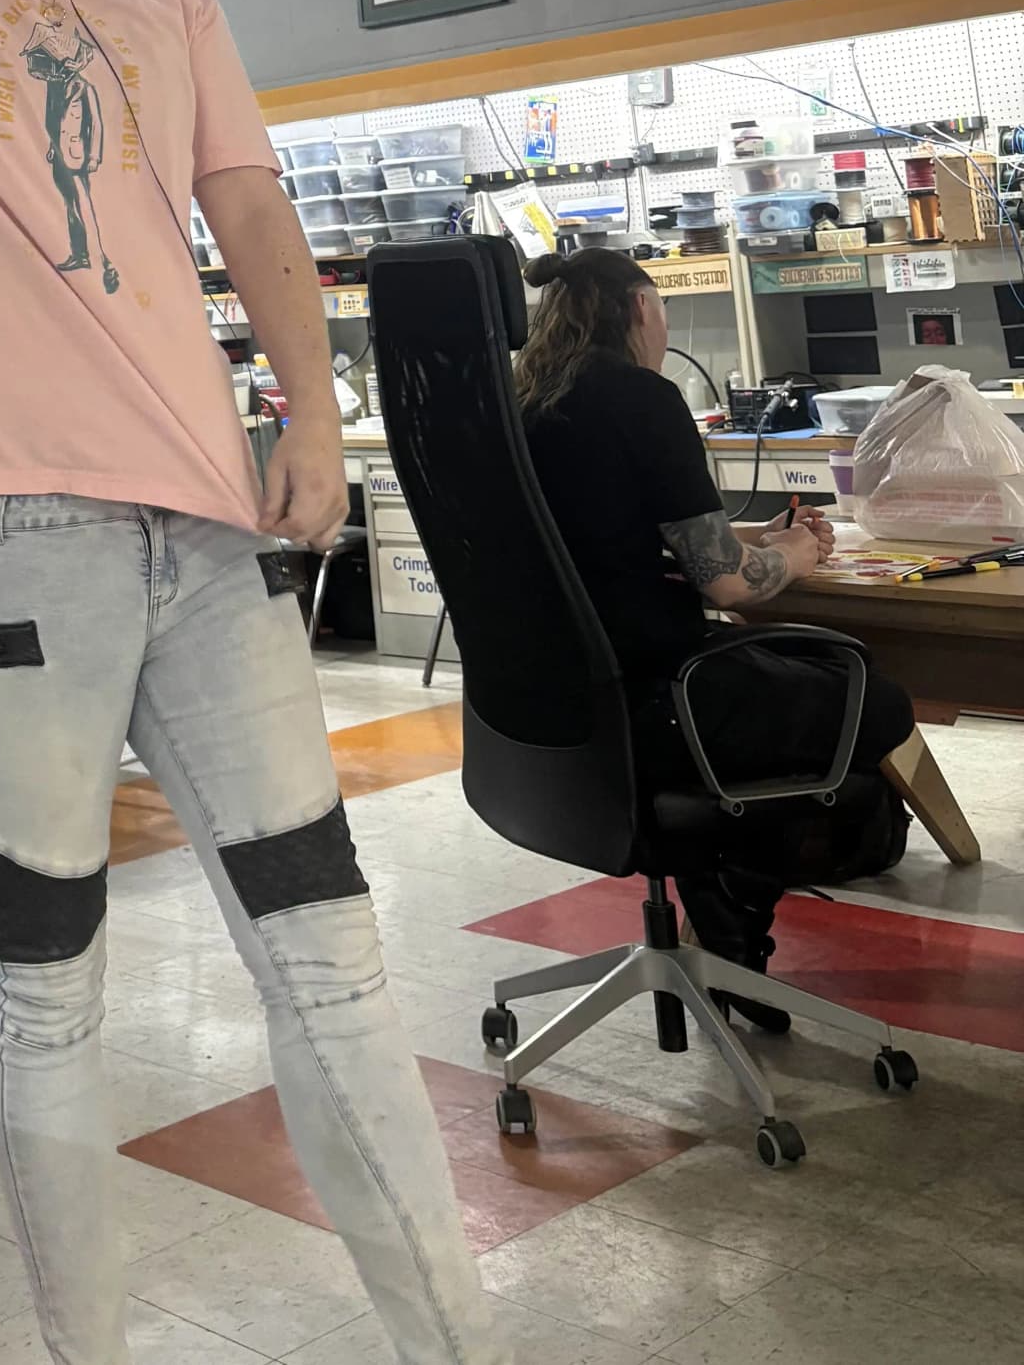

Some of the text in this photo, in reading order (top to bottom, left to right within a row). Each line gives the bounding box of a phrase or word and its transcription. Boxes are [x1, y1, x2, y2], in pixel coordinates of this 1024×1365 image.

[122, 64, 140, 90] MY
[693, 269, 727, 286] STATION
[370, 478, 398, 491] Wire
[785, 471, 817, 484] Wire
[392, 556, 432, 574] Crimp
[408, 577, 439, 593] Tool
